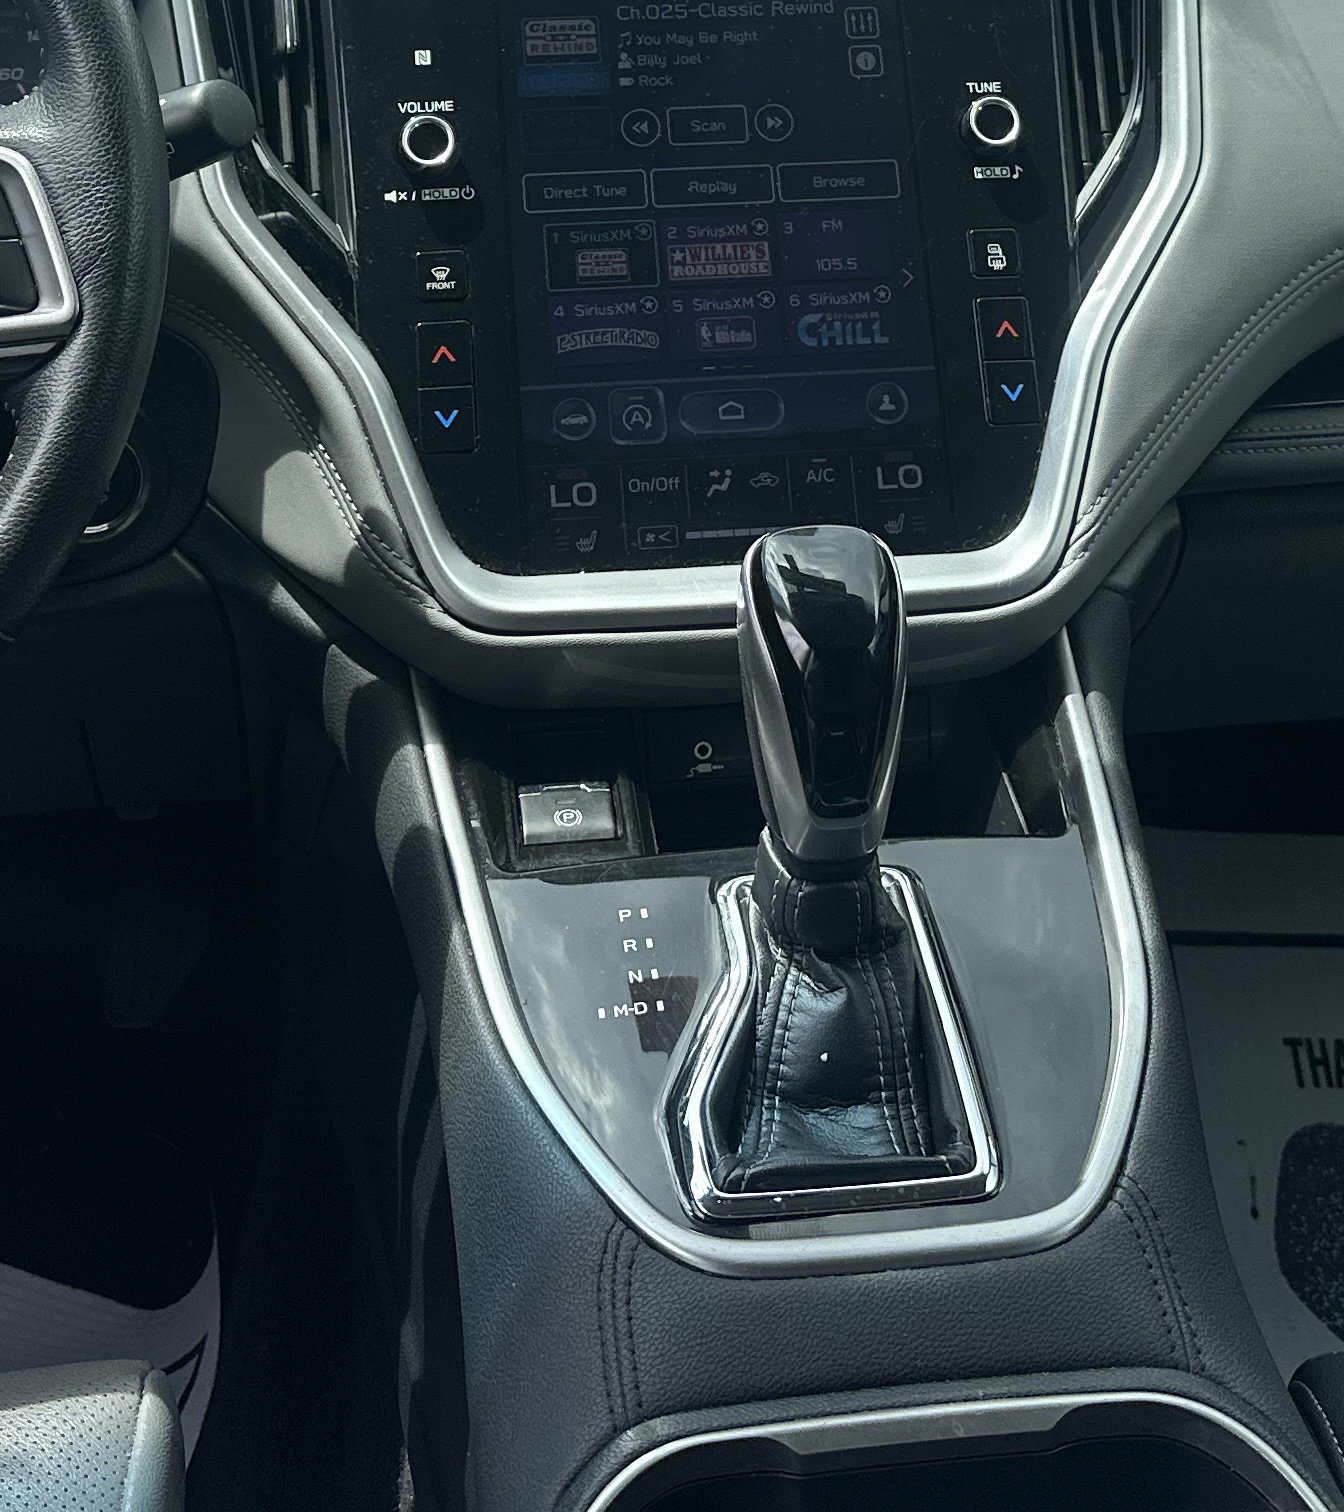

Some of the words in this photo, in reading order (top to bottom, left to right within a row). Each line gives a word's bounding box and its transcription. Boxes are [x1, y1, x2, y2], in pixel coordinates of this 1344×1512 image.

[771, 0, 834, 16] Rewind
[529, 22, 594, 33] Classic
[636, 34, 662, 47] You
[665, 33, 696, 48] May
[698, 32, 719, 43] Be
[722, 30, 760, 45] Right
[637, 53, 668, 69] Billy
[671, 52, 703, 66] Joel
[638, 74, 674, 88] Rock
[966, 82, 1002, 93] TUNE
[398, 101, 454, 113] VOLUME
[690, 119, 727, 133] Scan
[975, 168, 1010, 178] HOLD
[689, 179, 738, 195] Replay
[812, 174, 866, 189] Browse
[423, 189, 459, 199] HOLD
[543, 185, 588, 200] Direct
[593, 183, 627, 198] Tune
[667, 227, 677, 239] 2
[686, 224, 748, 238] SiriusXM
[784, 222, 794, 234] 3
[822, 219, 843, 233] FM
[570, 229, 632, 244] SiriusXM
[687, 244, 766, 263] WILLIE'S
[672, 262, 770, 278] ROADHOUSE
[816, 257, 858, 272] 105.5
[427, 281, 456, 291] FRONT
[672, 300, 683, 313] 5
[693, 297, 754, 311] SiriusXM
[789, 294, 800, 307] 6
[809, 291, 870, 306] SiriusXM
[554, 305, 565, 317] 4
[574, 302, 637, 317] SiriusXM
[798, 313, 890, 346] CHILL
[806, 467, 836, 484] A/C
[876, 464, 923, 491] LO
[628, 477, 680, 494] On/Off
[549, 481, 598, 509] LO
[618, 909, 632, 922] P
[622, 939, 638, 952] R
[628, 970, 643, 983] N
